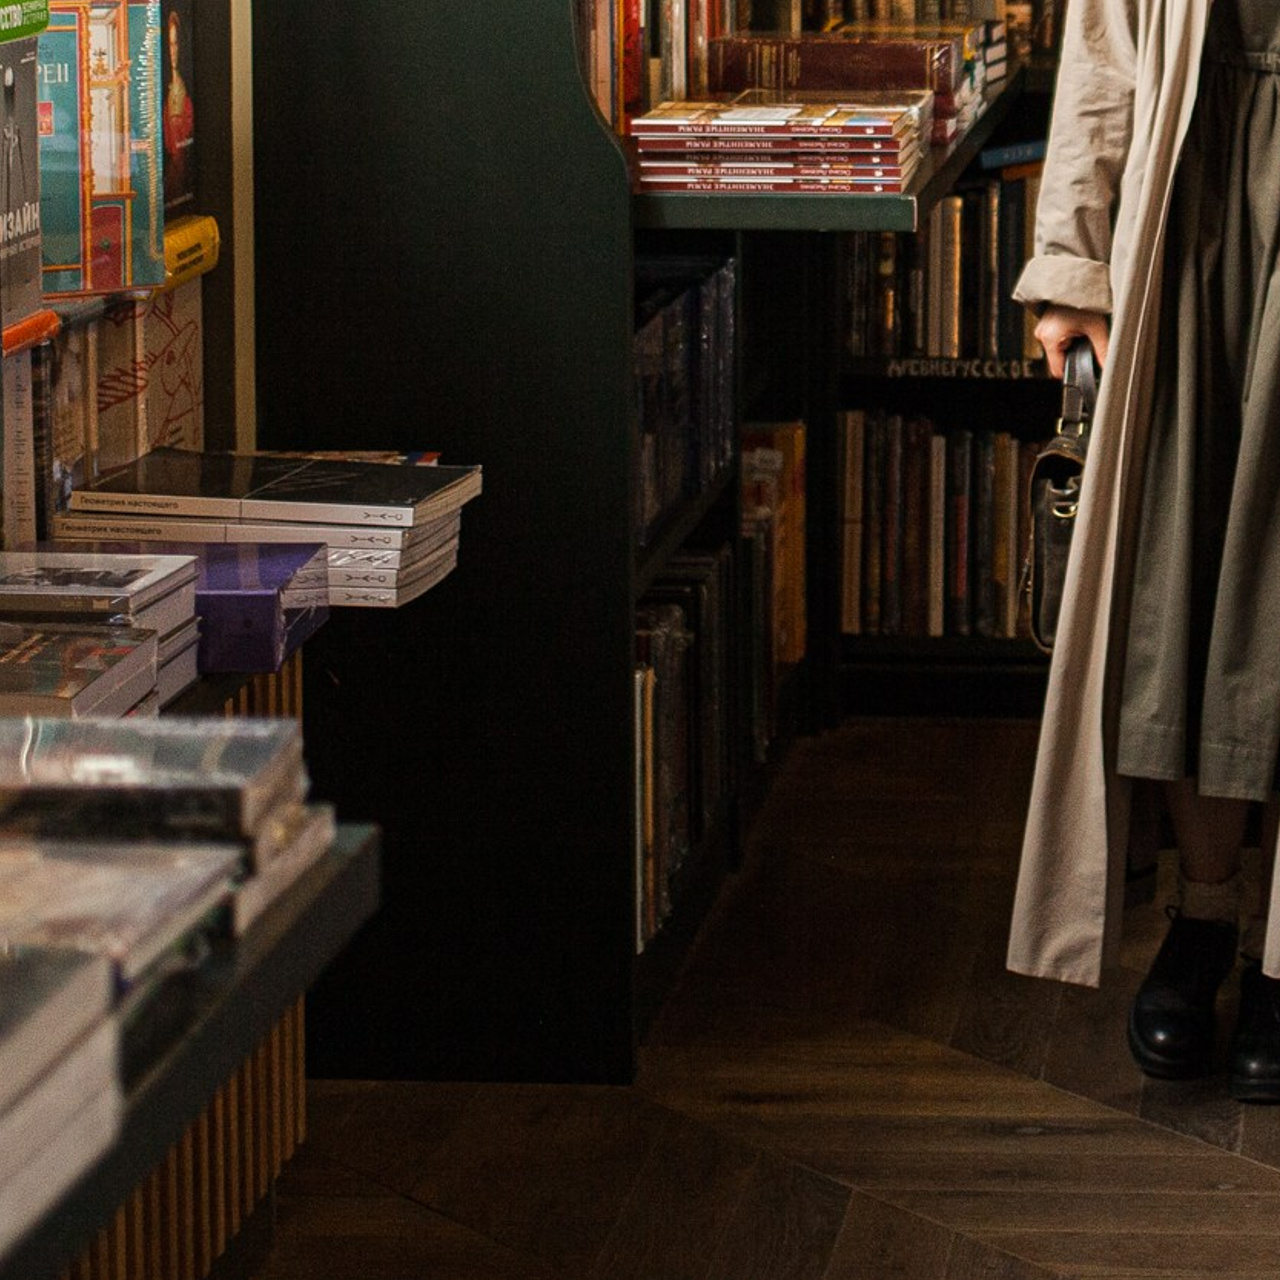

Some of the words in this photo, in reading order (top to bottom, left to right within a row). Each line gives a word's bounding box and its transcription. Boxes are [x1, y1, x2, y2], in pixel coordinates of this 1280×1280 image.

[677, 125, 704, 134] РАМЫ
[704, 125, 766, 134] ЗНАМЕНИТЫЕ
[687, 167, 713, 176] РАМЫ
[713, 167, 775, 176] ЗНАМЕНИТЫЕ
[686, 182, 712, 191] РАМЫ
[713, 182, 774, 191] ЗНАМЕНИТЫЕ
[80, 496, 126, 509] Геометрия
[128, 499, 179, 511] настоящего
[61, 522, 109, 536] Геометрия
[110, 525, 162, 536] настоящего
